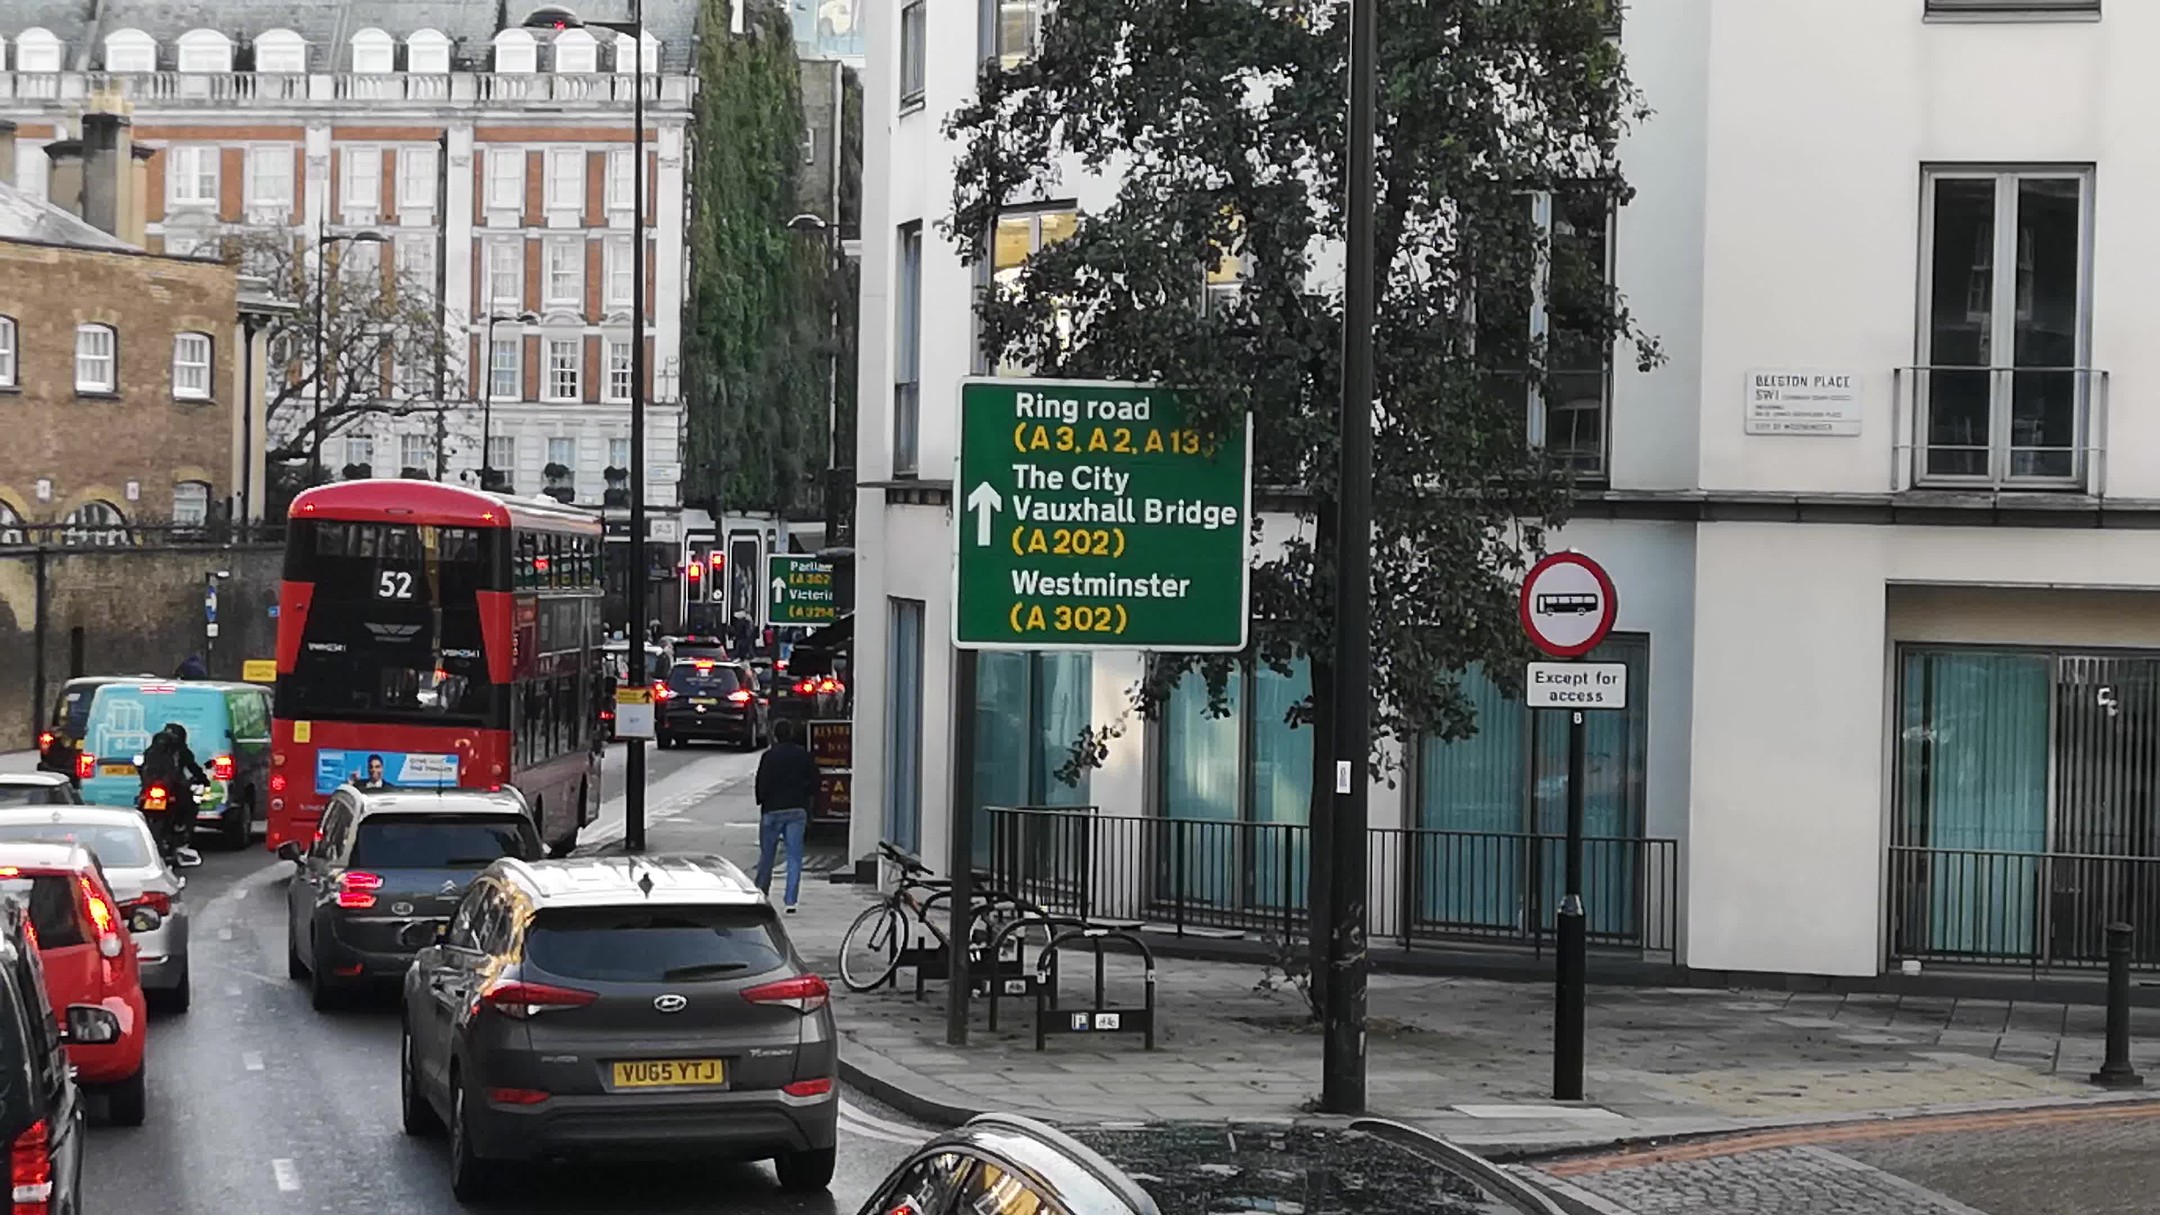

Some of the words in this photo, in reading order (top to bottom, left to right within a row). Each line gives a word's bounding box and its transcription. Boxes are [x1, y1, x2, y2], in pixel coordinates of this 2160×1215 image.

[1814, 375, 1850, 388] PLACE
[1016, 392, 1078, 423] Ring
[1087, 397, 1150, 420] road
[1012, 464, 1063, 490] The
[1072, 465, 1130, 495] City
[1012, 495, 1135, 523] Vauxhall
[1145, 498, 1237, 529] Bridge
[378, 571, 412, 598] 52
[1012, 570, 1190, 598] Westminster
[1535, 671, 1588, 687] Except
[1596, 671, 1618, 685] for
[1549, 690, 1604, 702] access
[623, 1063, 672, 1083] VU65
[678, 1061, 716, 1080] YTJ
